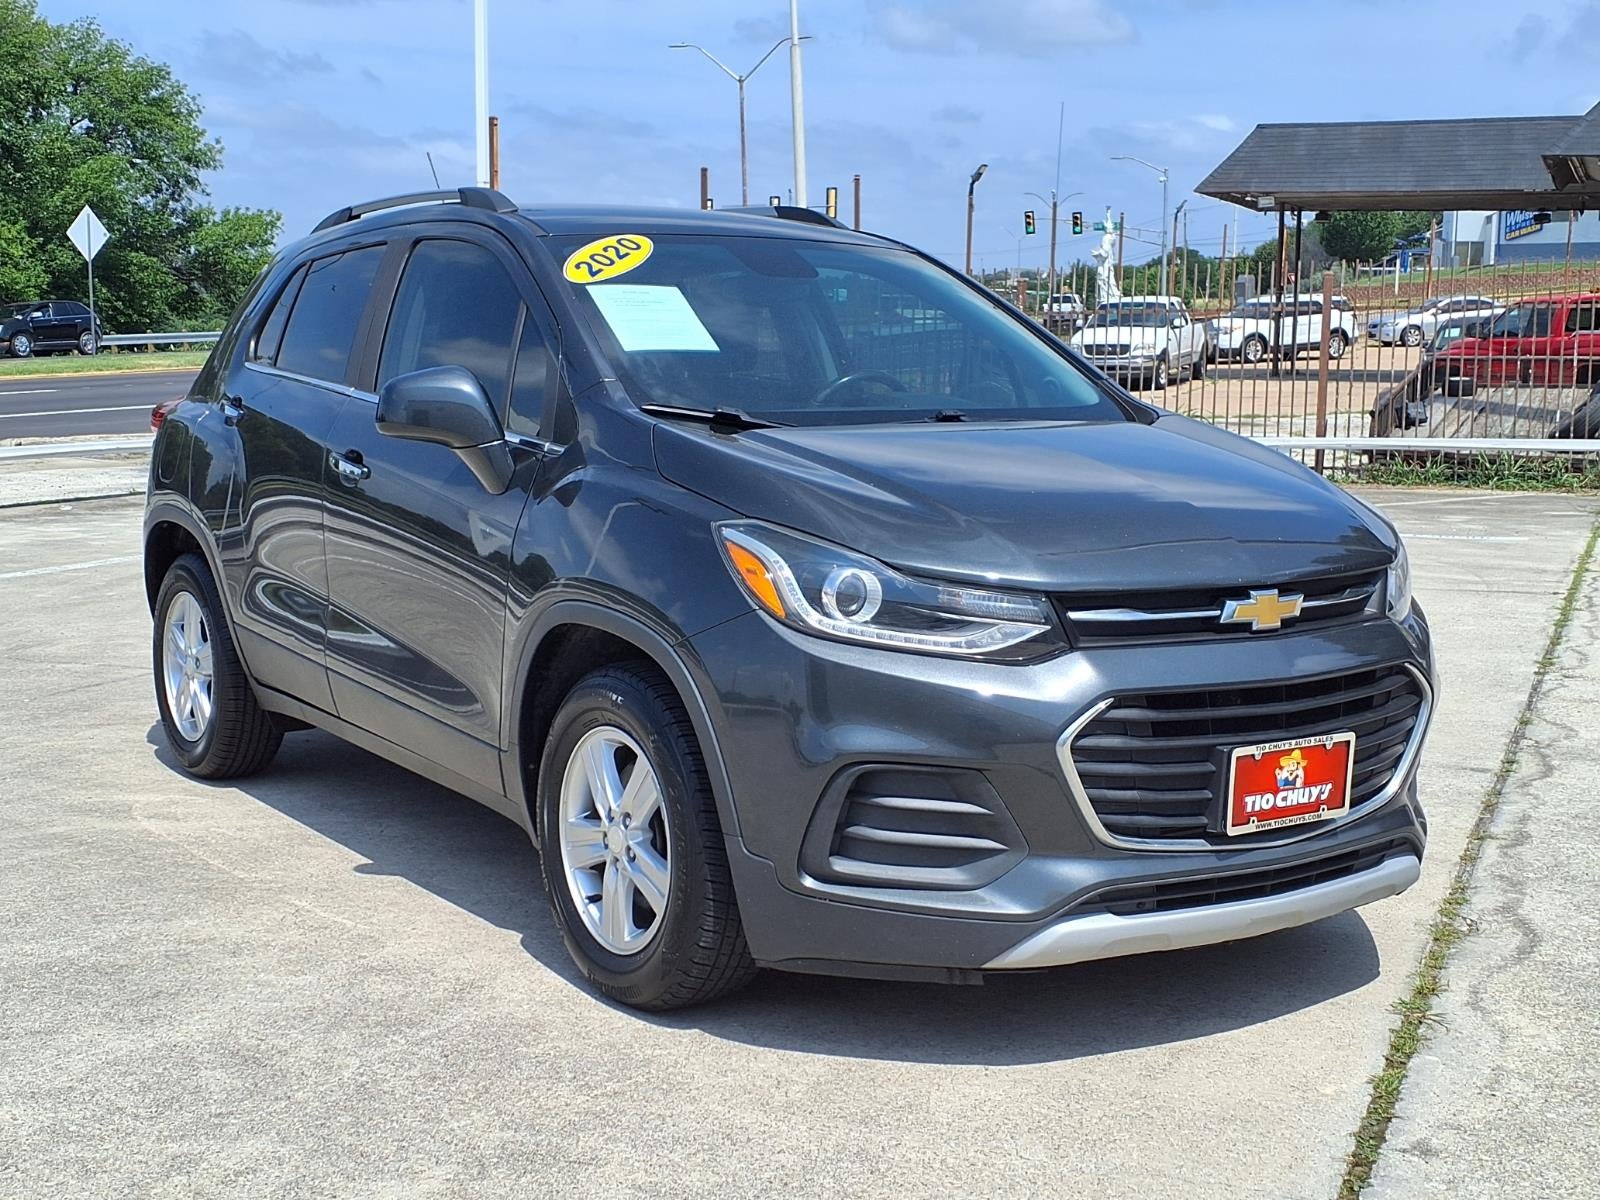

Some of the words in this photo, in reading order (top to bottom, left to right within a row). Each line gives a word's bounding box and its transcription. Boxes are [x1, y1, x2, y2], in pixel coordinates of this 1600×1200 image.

[1506, 230, 1520, 240] CAR
[1520, 223, 1541, 235] WASH
[574, 237, 642, 278] 2020
[1268, 741, 1293, 750] CHUY'S
[1294, 738, 1312, 747] AUTO
[1313, 735, 1334, 744] SALES
[1243, 792, 1275, 813] TIO
[1275, 782, 1333, 809] CHUY'S
[1255, 812, 1322, 830] WWW.TIOCHUYS.COM
